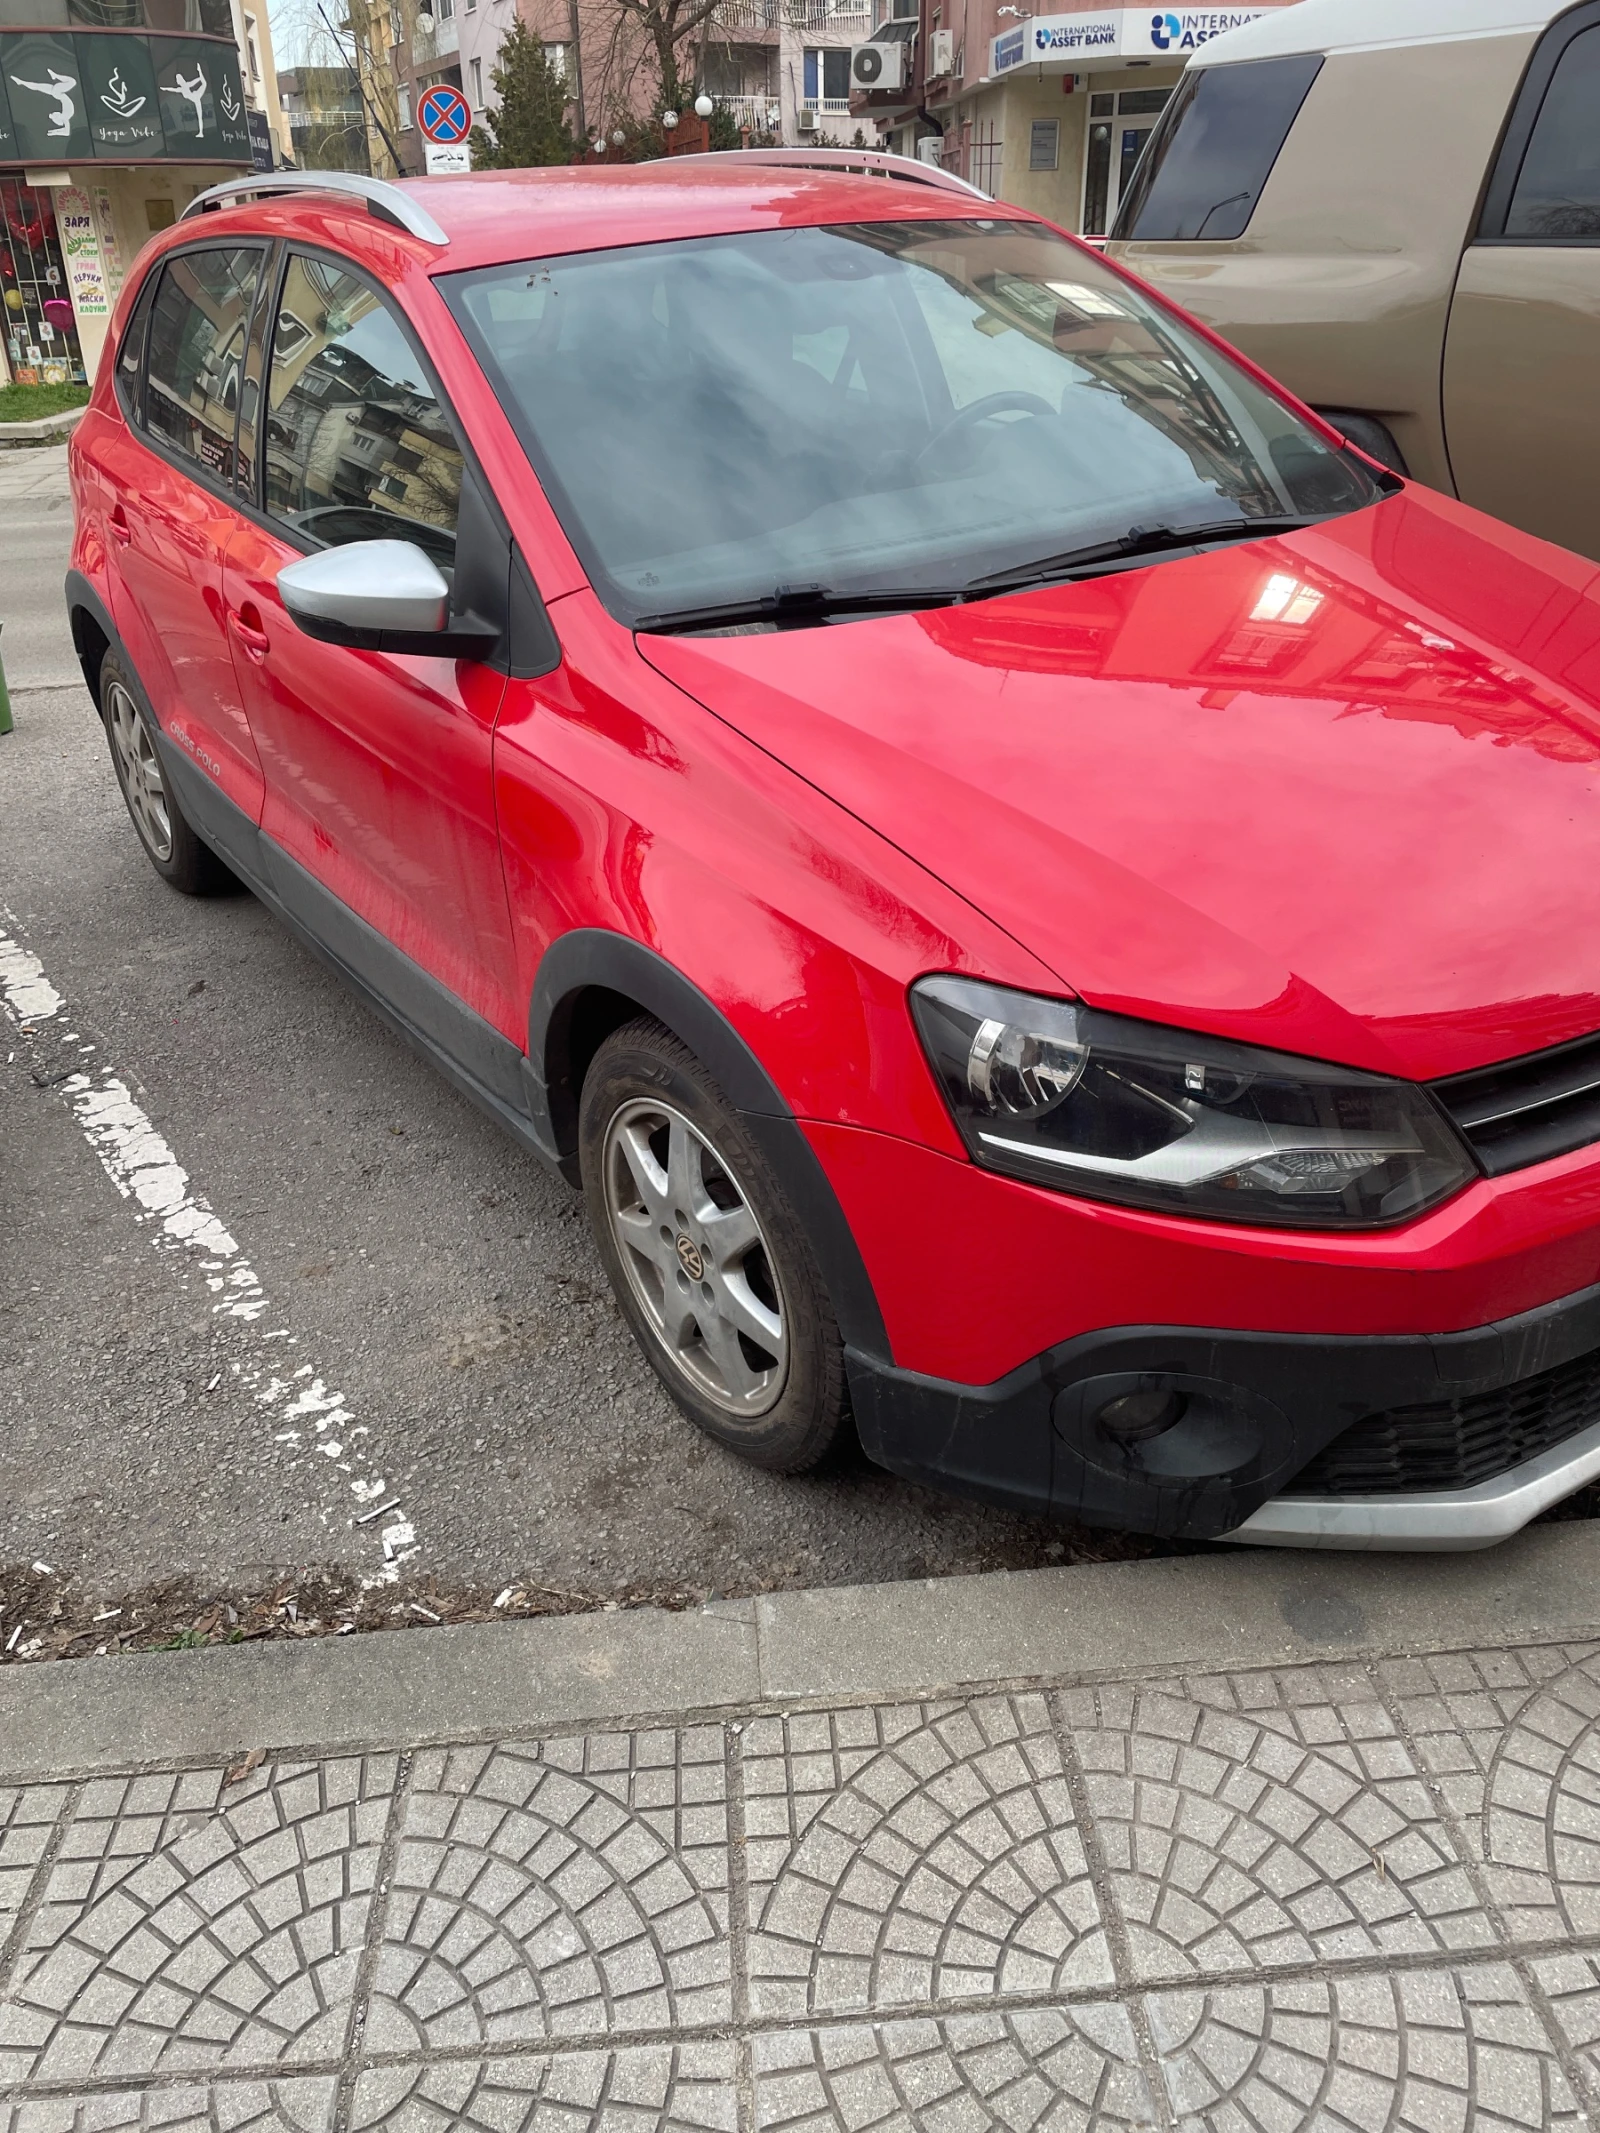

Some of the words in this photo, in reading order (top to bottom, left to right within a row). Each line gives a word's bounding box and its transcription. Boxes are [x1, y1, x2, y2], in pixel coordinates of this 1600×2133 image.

[1050, 23, 1116, 37] INTERNATIONAL
[1050, 35, 1083, 49] ASSET
[1085, 32, 1116, 46] BANK
[99, 127, 128, 142] Yoga
[130, 126, 158, 138] Vibe
[64, 216, 90, 228] ЗАРЯ
[76, 262, 97, 271] ГРИМ
[49, 270, 57, 280] 6
[73, 272, 102, 284] ПЕРУКИ
[78, 294, 104, 303] МАСКИ
[79, 304, 107, 313] КЛОУНИ
[170, 721, 195, 753] CROSS
[196, 747, 220, 777] POLO
